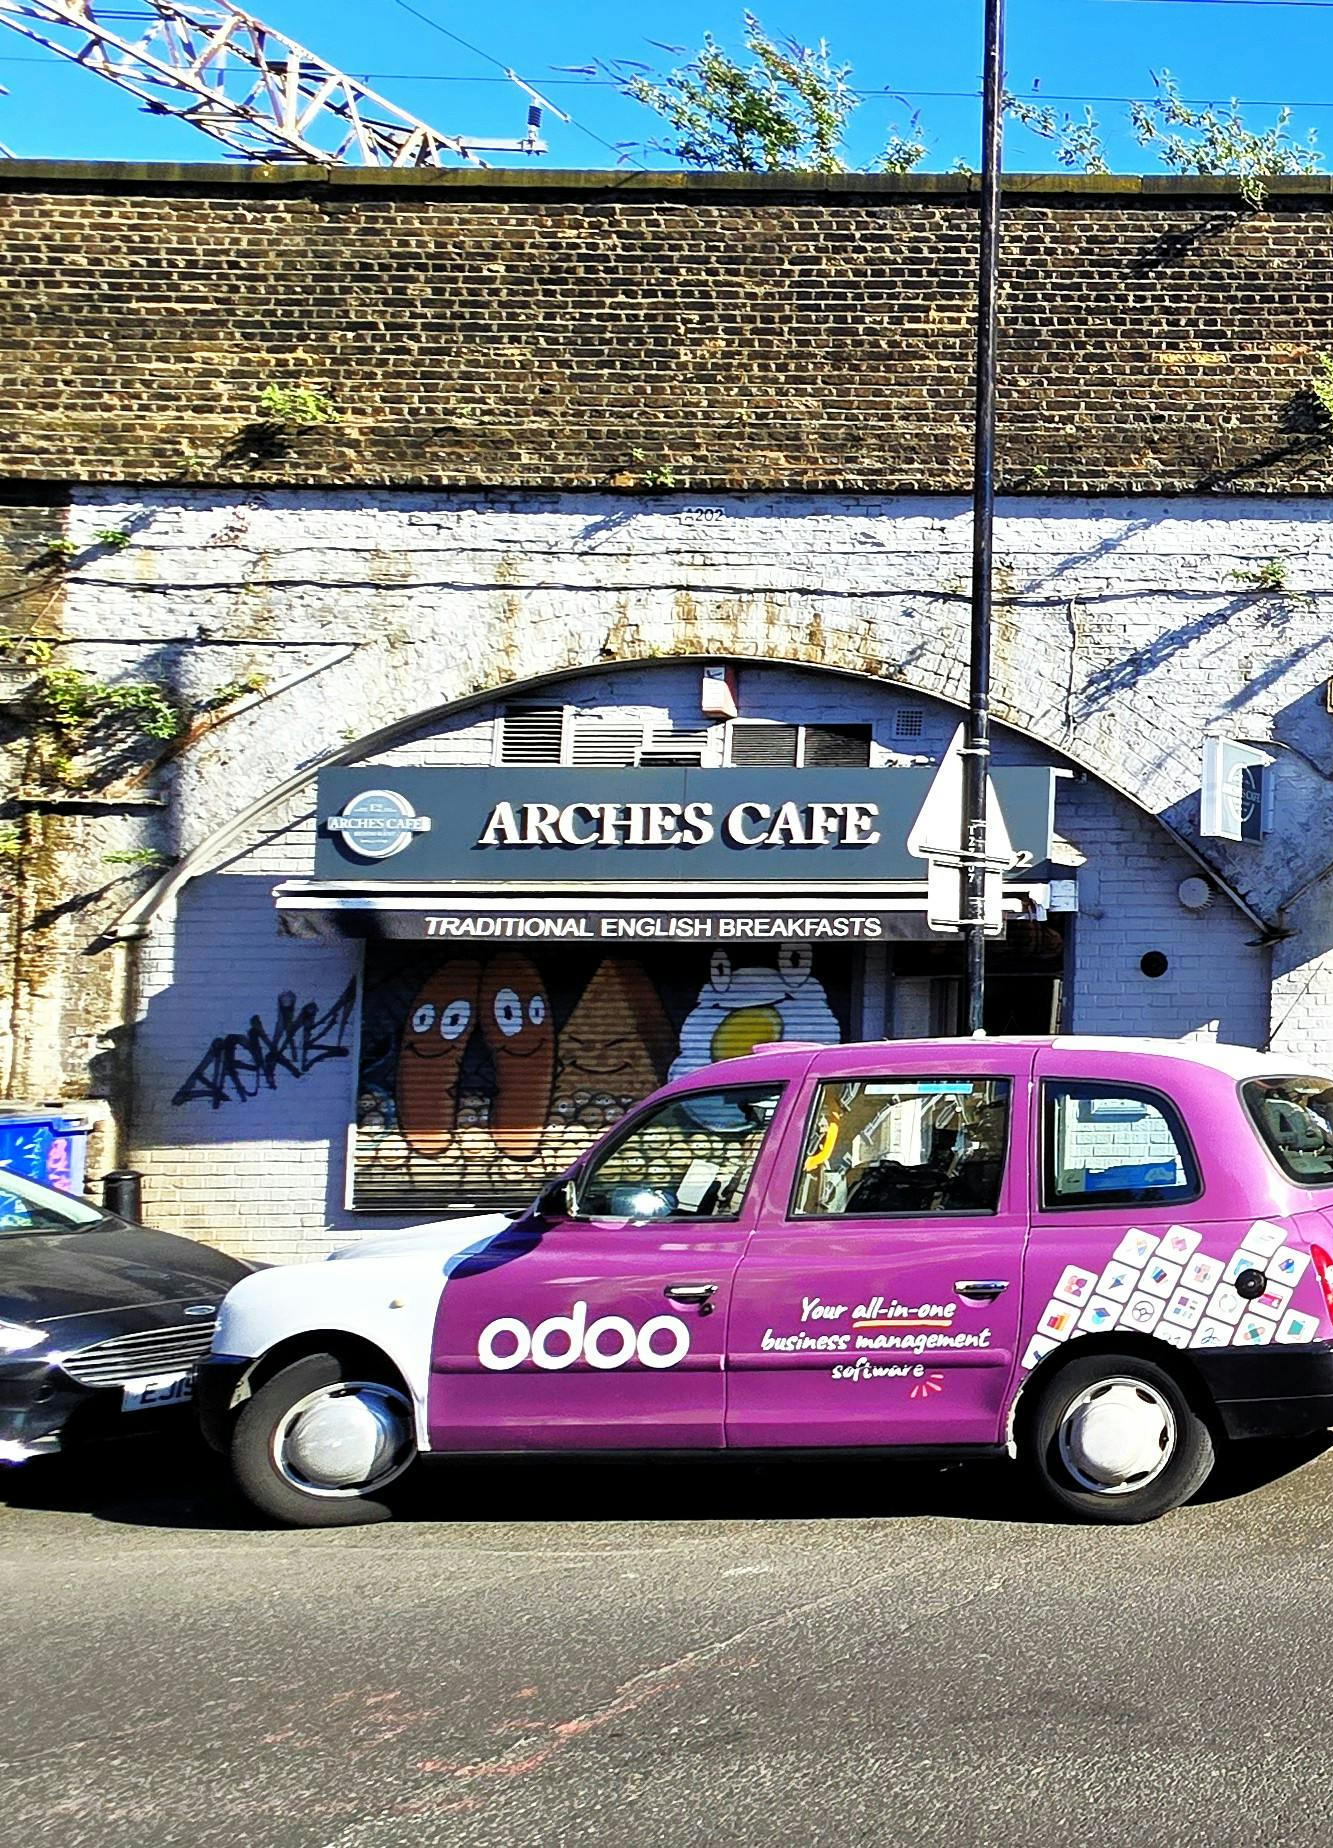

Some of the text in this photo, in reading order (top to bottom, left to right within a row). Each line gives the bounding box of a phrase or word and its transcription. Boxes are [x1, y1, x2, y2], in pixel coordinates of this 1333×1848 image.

[685, 508, 723, 521] A202
[330, 817, 421, 829] ARCHES CAFE
[478, 801, 881, 845] ARCHES CAFE
[425, 917, 882, 937] TRADITIONAL ENGLISH BREAKFASTS
[801, 1297, 957, 1321] Your all-in-one
[478, 1300, 690, 1371] odoo
[761, 1328, 992, 1355] business management
[832, 1356, 925, 1382] software
